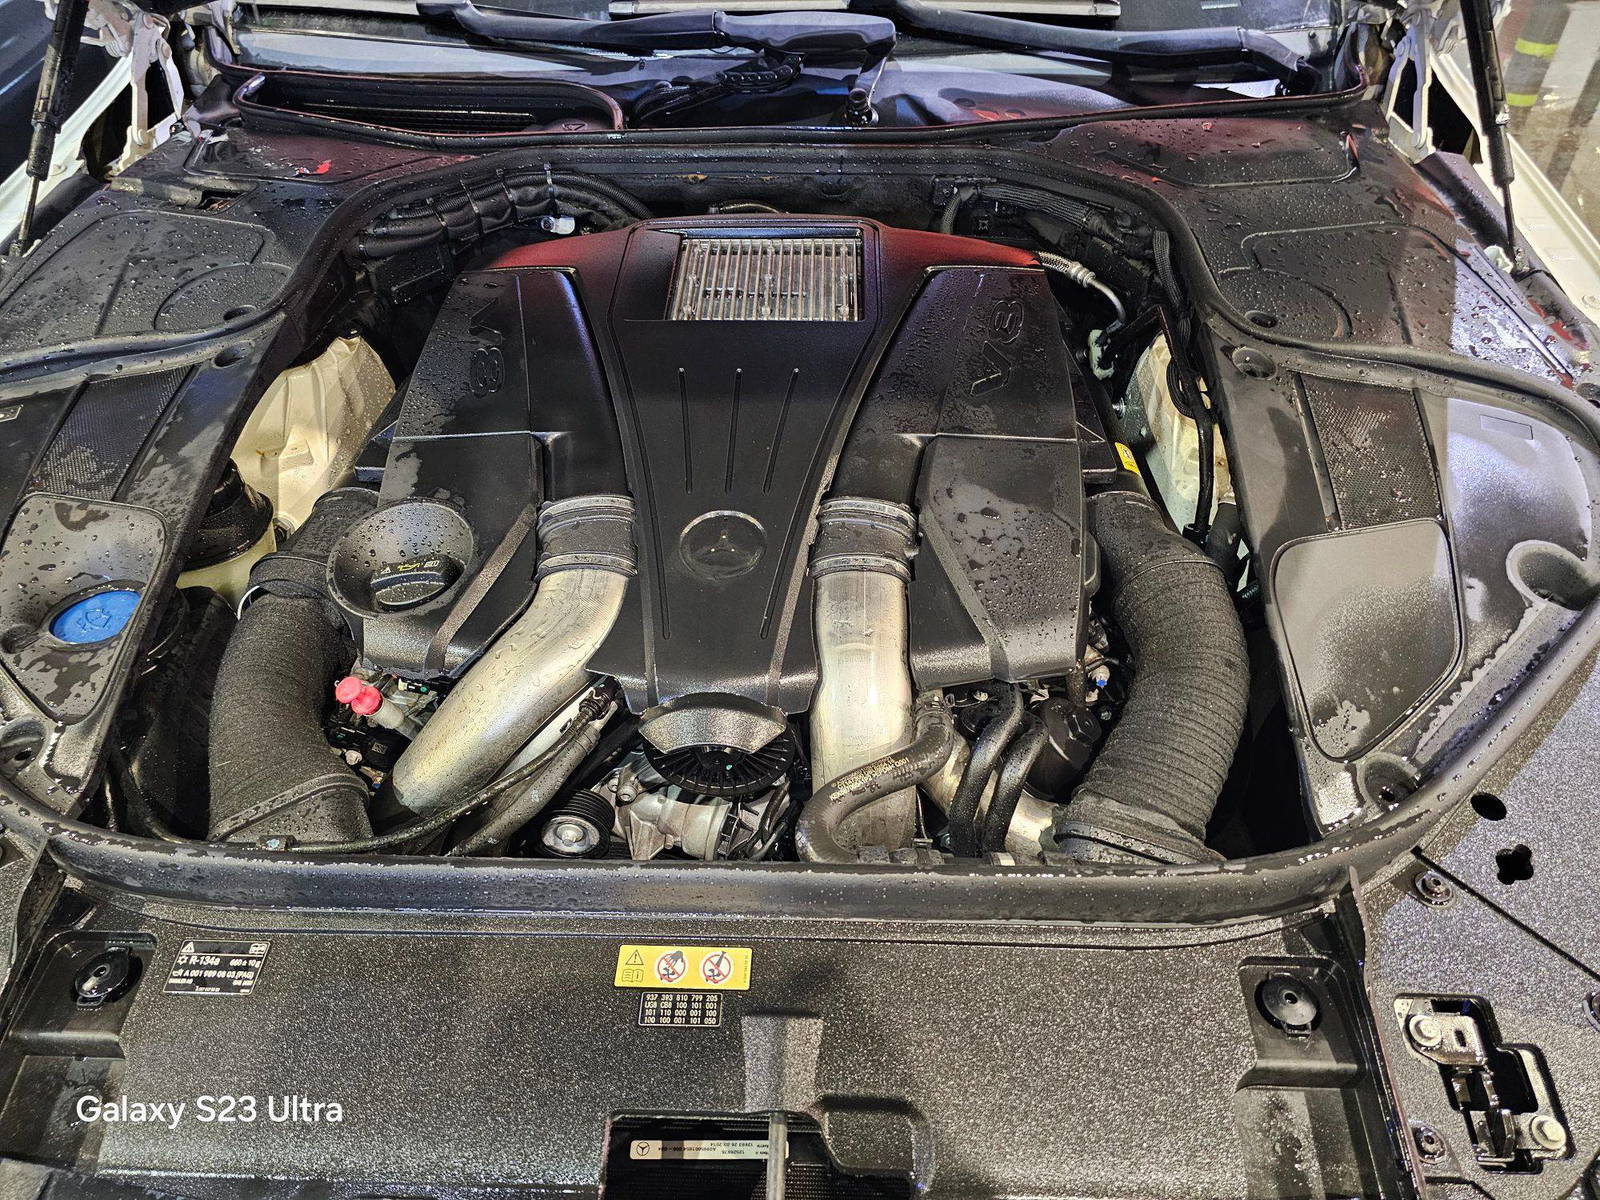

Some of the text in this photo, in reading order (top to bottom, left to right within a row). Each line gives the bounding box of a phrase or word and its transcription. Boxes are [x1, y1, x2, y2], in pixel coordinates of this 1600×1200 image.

[469, 297, 505, 398] V8
[969, 299, 1025, 397] V8
[189, 955, 221, 966] R-134a
[676, 1001, 688, 1009] 100
[691, 1001, 702, 1009] 101
[705, 1001, 717, 1009] 001
[644, 1016, 656, 1024] 100
[659, 1016, 671, 1024] 100
[673, 1016, 686, 1024] 001
[690, 1016, 701, 1024] 101
